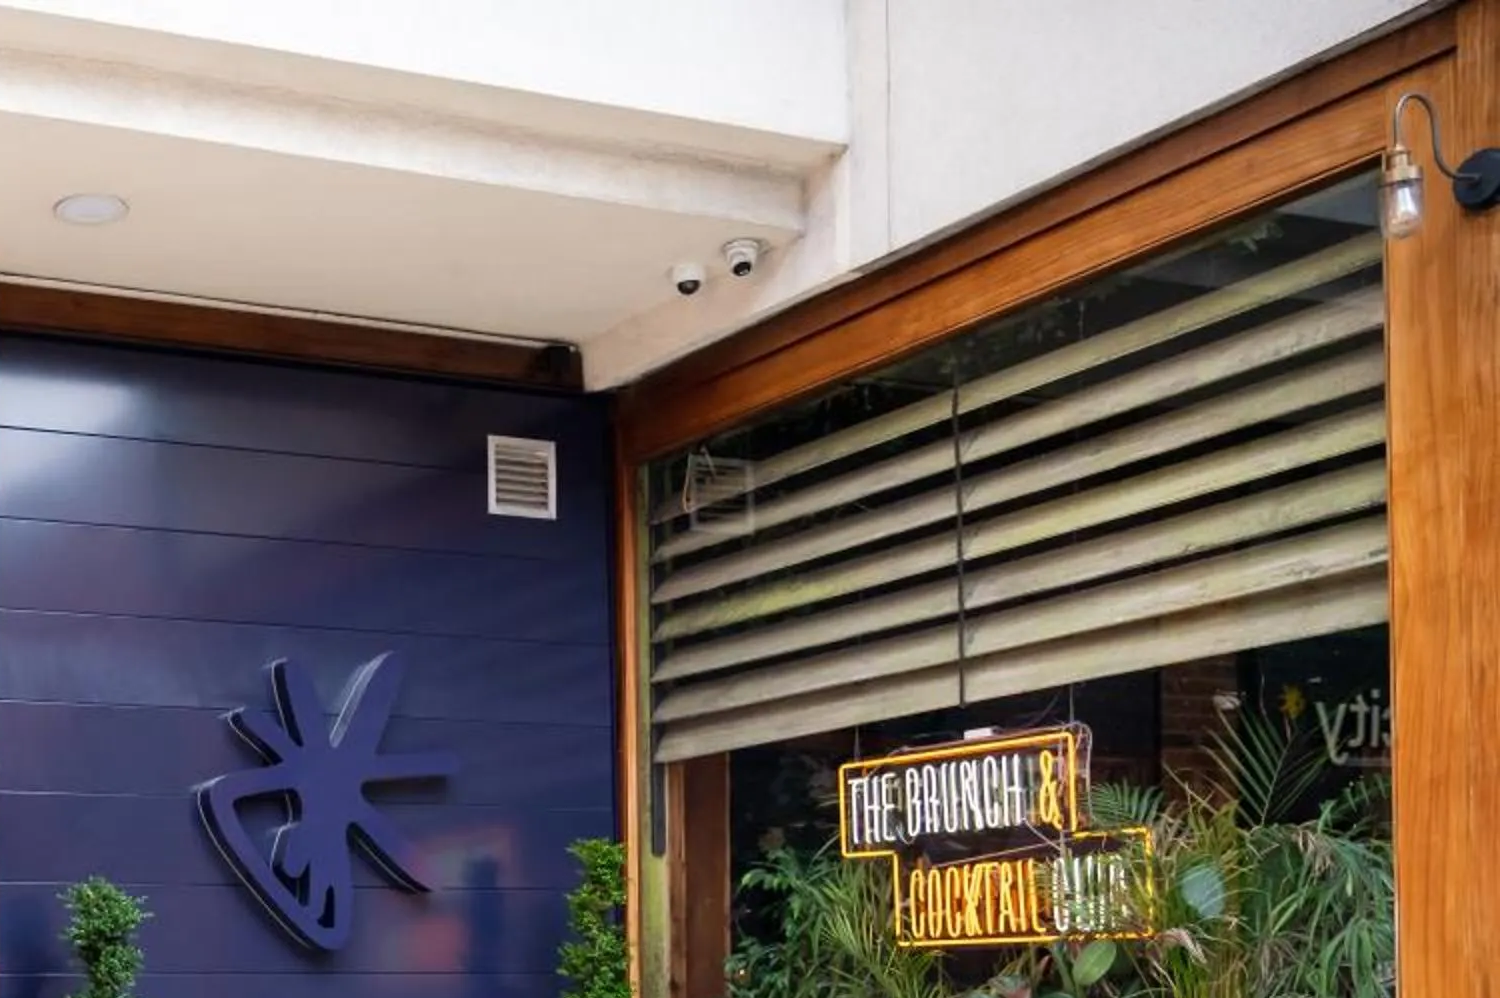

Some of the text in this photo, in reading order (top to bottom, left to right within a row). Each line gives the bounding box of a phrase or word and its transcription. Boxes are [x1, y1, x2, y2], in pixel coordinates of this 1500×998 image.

[847, 750, 1062, 845] THE BRUNCH &
[910, 857, 1046, 938] COCKTAIL
